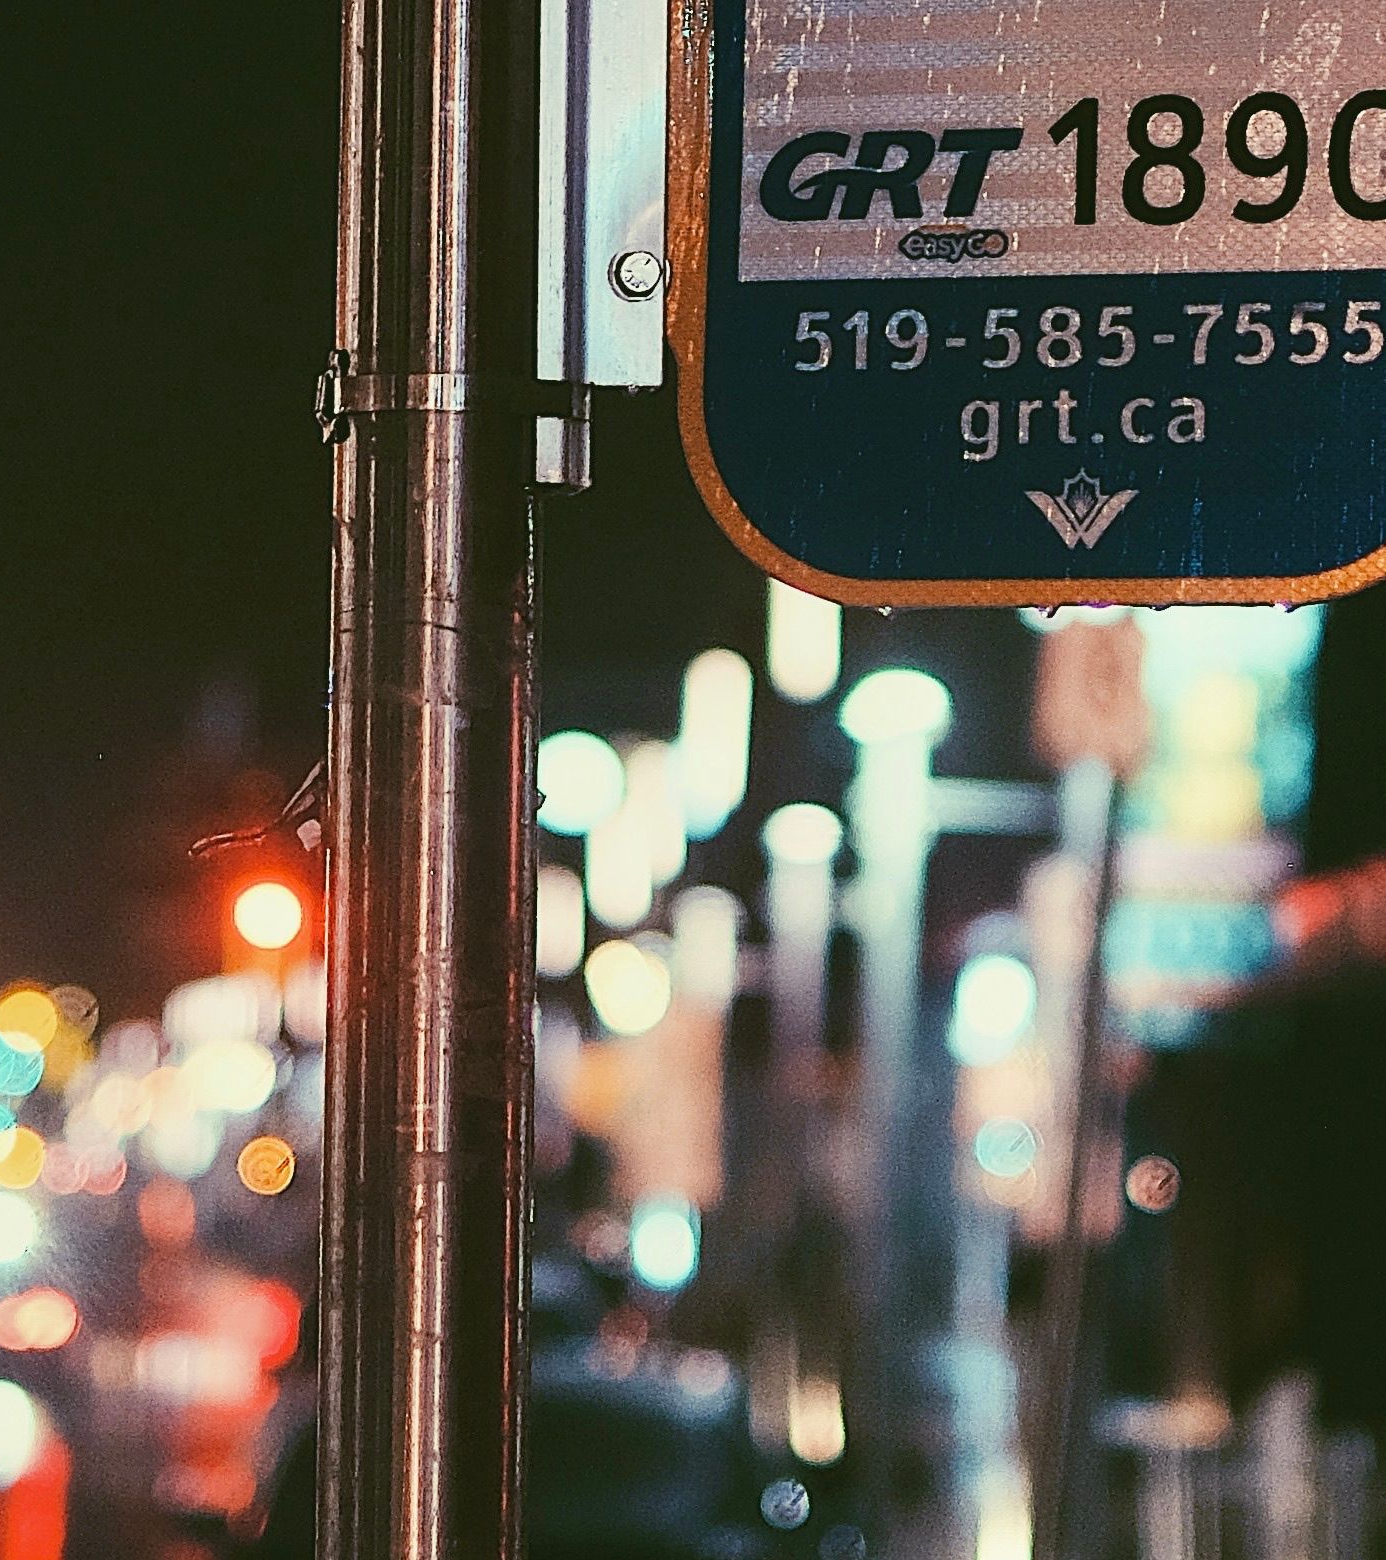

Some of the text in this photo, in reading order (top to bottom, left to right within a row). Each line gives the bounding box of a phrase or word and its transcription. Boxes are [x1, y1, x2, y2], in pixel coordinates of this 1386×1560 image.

[758, 127, 1024, 222] GRT
[794, 300, 1386, 372] 519-585-7555
[960, 388, 1207, 462] grt.ca
